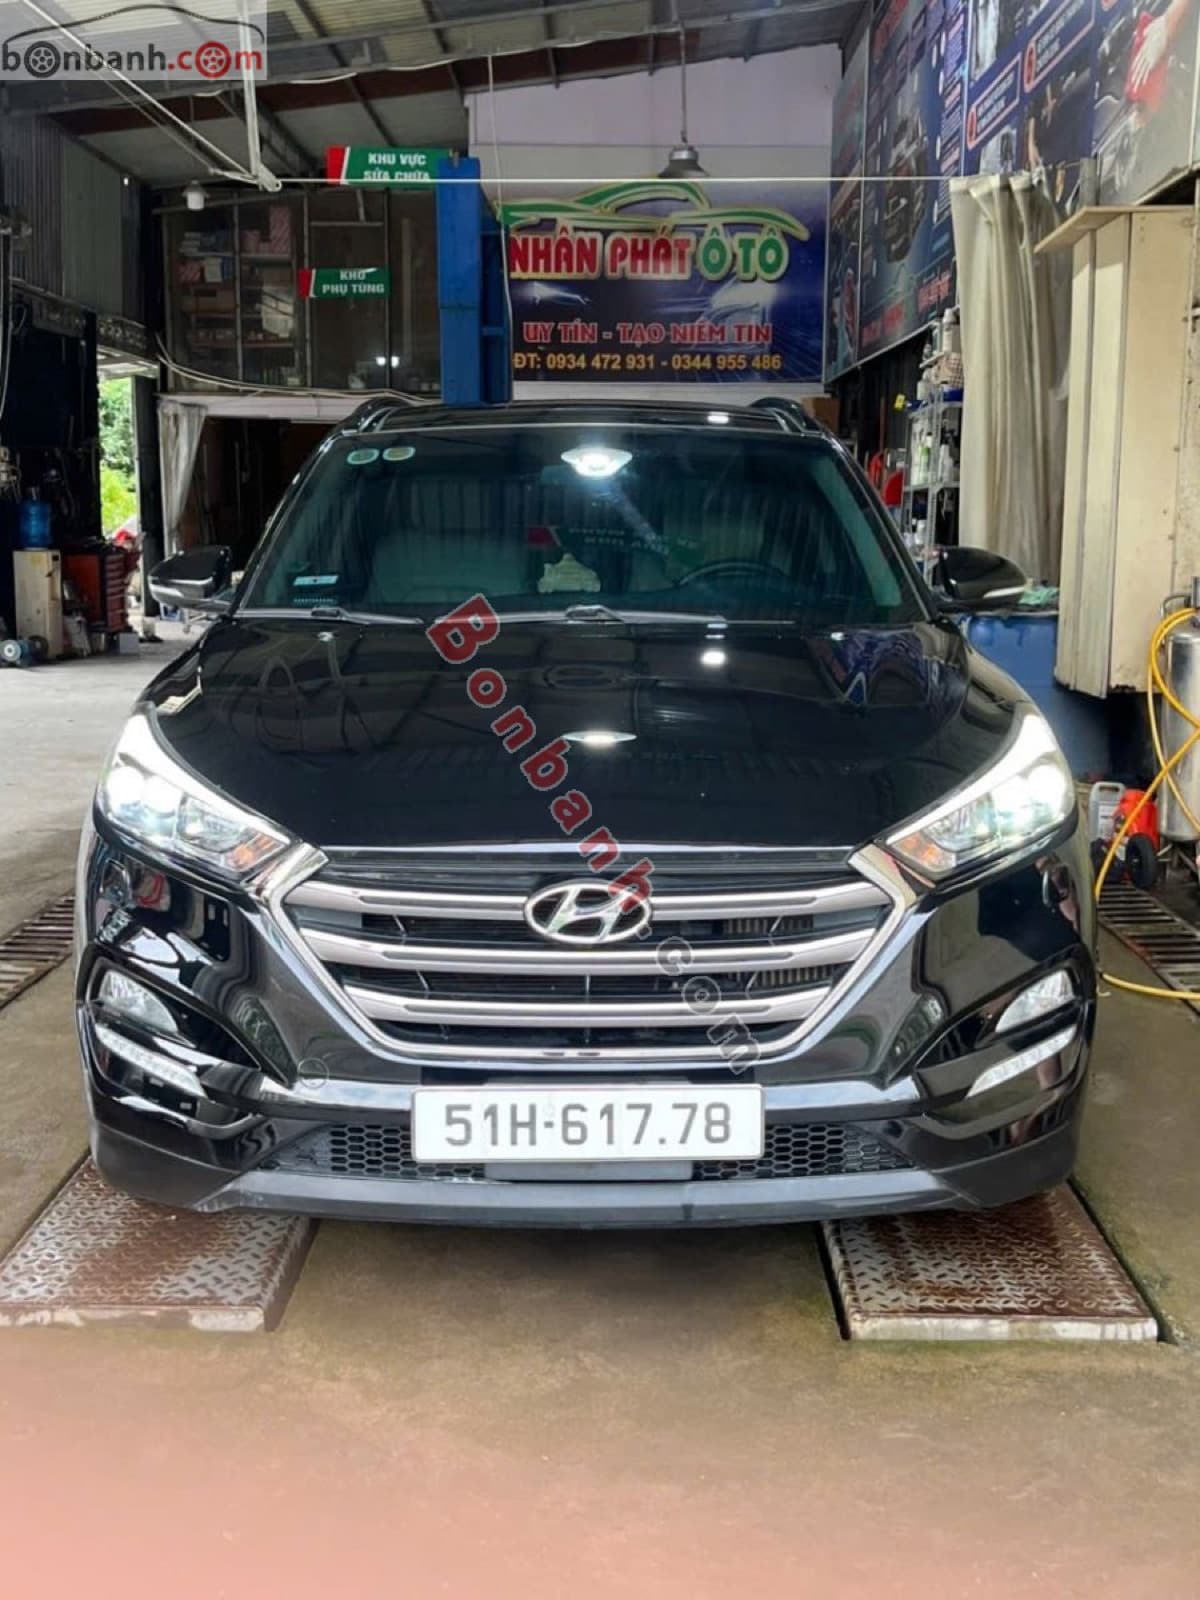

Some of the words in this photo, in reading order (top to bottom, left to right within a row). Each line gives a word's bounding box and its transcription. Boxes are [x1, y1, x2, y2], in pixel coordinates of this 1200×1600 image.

[368, 152, 396, 165] KHU
[400, 152, 427, 168] VỰC
[509, 224, 598, 274] NHÂN
[608, 224, 692, 275] PHÁT
[701, 226, 728, 275] Ô
[738, 226, 784, 275] TÔ
[340, 270, 366, 281] KHO
[322, 284, 348, 296] PHỤ
[523, 321, 554, 343] UY
[557, 318, 598, 343] TÍN
[616, 322, 666, 348] TẠO
[733, 322, 772, 344] TIN
[514, 353, 541, 369] ĐT:
[546, 353, 586, 369] 0934
[592, 354, 621, 369] 472
[626, 354, 655, 370] 931
[671, 354, 712, 370] 0344
[716, 354, 747, 370] 955
[751, 354, 783, 370] 486
[445, 1103, 732, 1147] 51H-617.78
